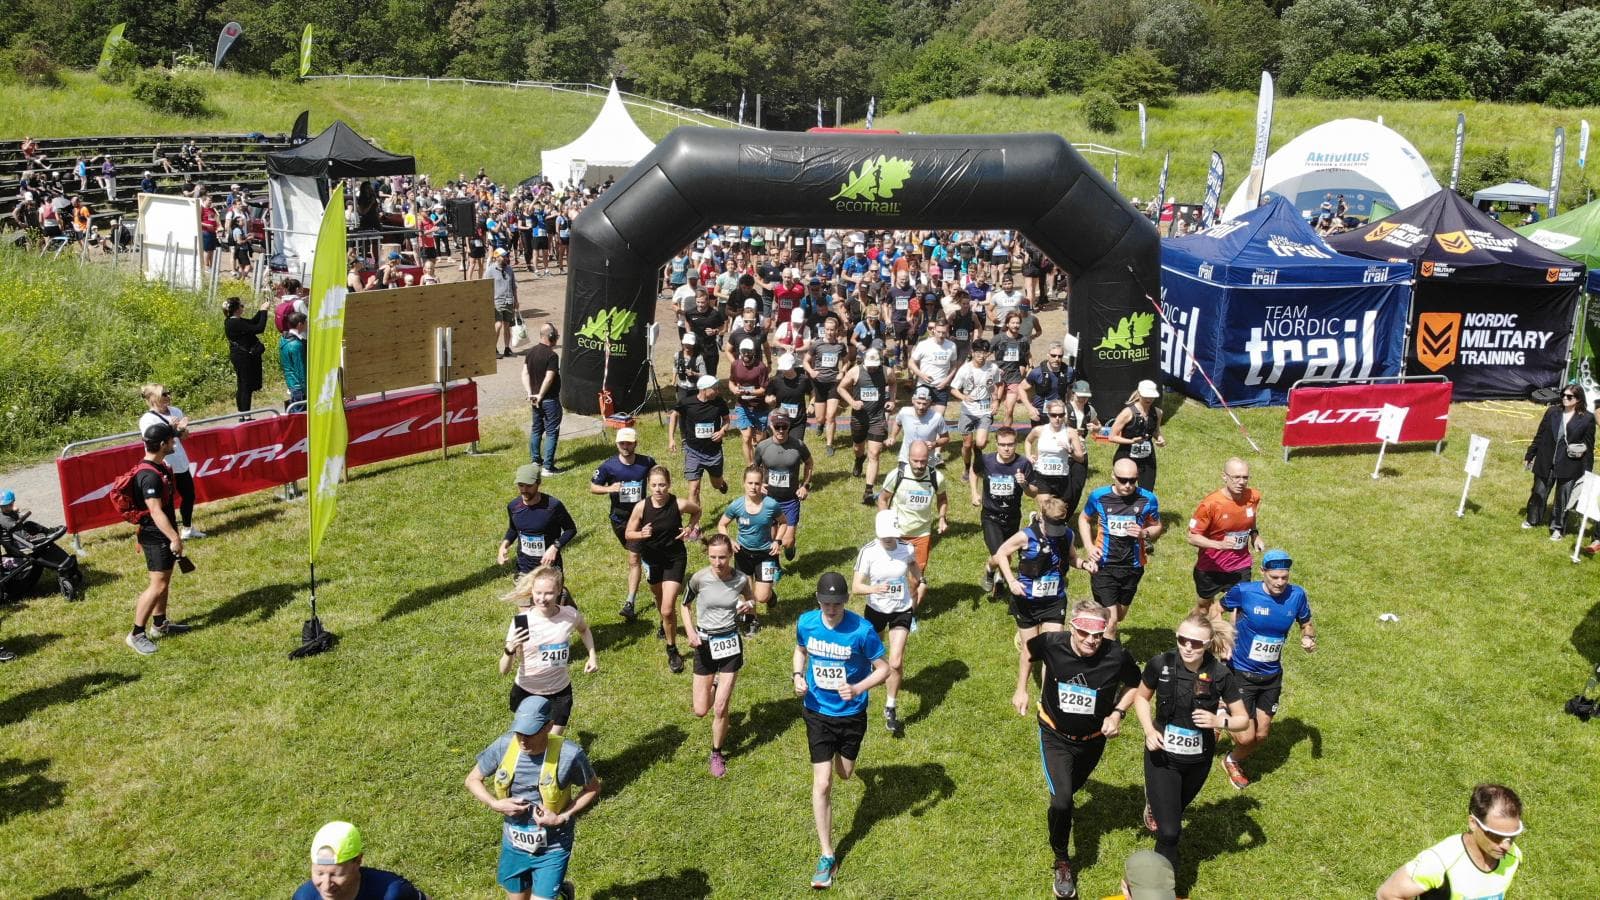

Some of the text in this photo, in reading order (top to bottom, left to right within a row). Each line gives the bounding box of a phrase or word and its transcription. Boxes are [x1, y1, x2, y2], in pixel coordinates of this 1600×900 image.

[1306, 151, 1370, 162] Aktivitus
[1267, 240, 1333, 258] trail
[1469, 236, 1518, 248] MILITARY
[1252, 269, 1278, 285] trail
[1363, 267, 1390, 283] trail
[1265, 305, 1308, 320] TEAM
[1464, 312, 1519, 328] NORDIC
[1263, 318, 1341, 338] NORDIC
[1460, 329, 1554, 350] MILITARY
[1244, 310, 1378, 386] trail
[1459, 350, 1526, 366] TRAINING
[696, 426, 714, 434] 2344
[1043, 463, 1062, 471] 2382
[621, 487, 641, 496] 2284
[991, 482, 1012, 491] 2235
[909, 495, 929, 504] 2001
[522, 540, 543, 550] 2069
[1036, 582, 1056, 591] 2371
[1253, 605, 1270, 616] trail
[713, 637, 737, 652] 2033
[806, 636, 852, 656] Aktivitus
[1255, 641, 1280, 653] 2468
[541, 649, 568, 661] 2416
[815, 666, 844, 679] 2432
[1060, 692, 1092, 708] 2282
[1167, 733, 1200, 748] 2268
[512, 830, 543, 845] 2004
